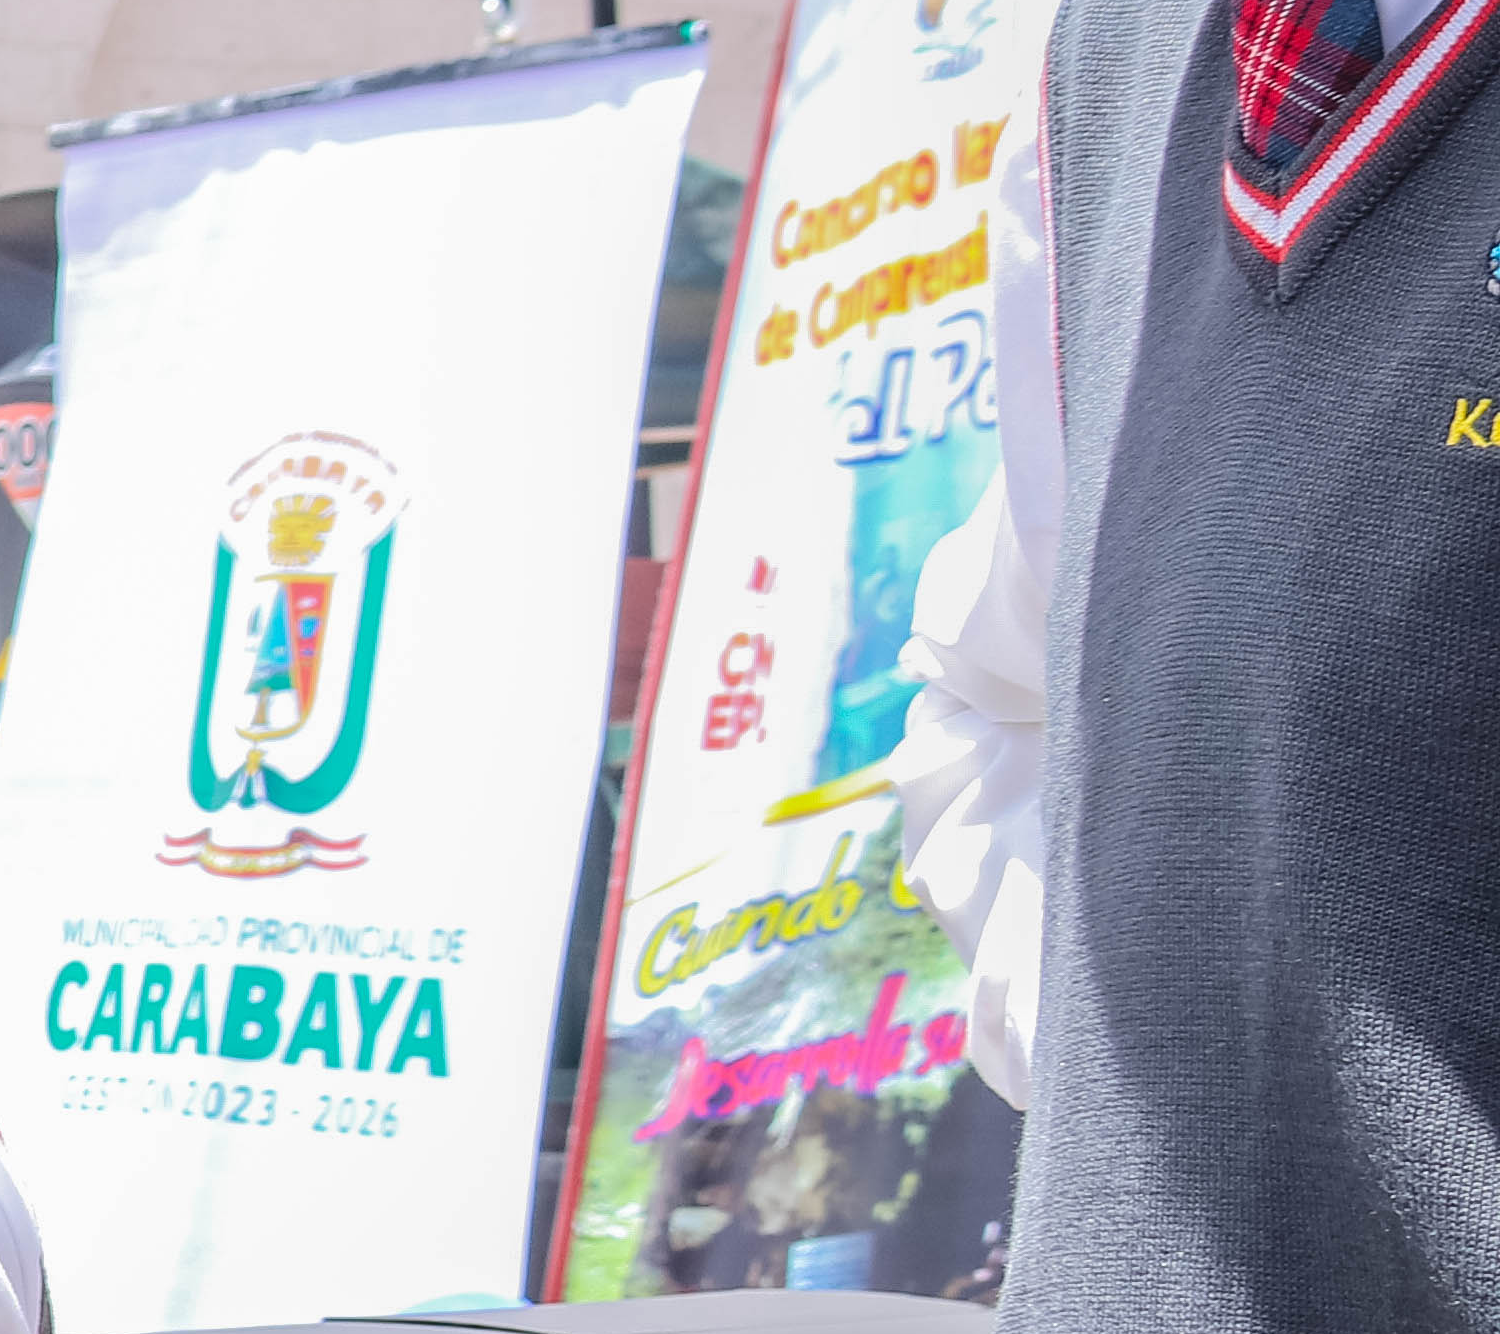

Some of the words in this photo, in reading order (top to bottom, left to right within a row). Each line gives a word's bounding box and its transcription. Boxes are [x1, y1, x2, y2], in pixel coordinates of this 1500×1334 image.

[428, 927, 468, 964] DE
[45, 960, 451, 1079] CARABAYA
[181, 1079, 279, 1127] 2023
[310, 1093, 400, 1139] 2026
